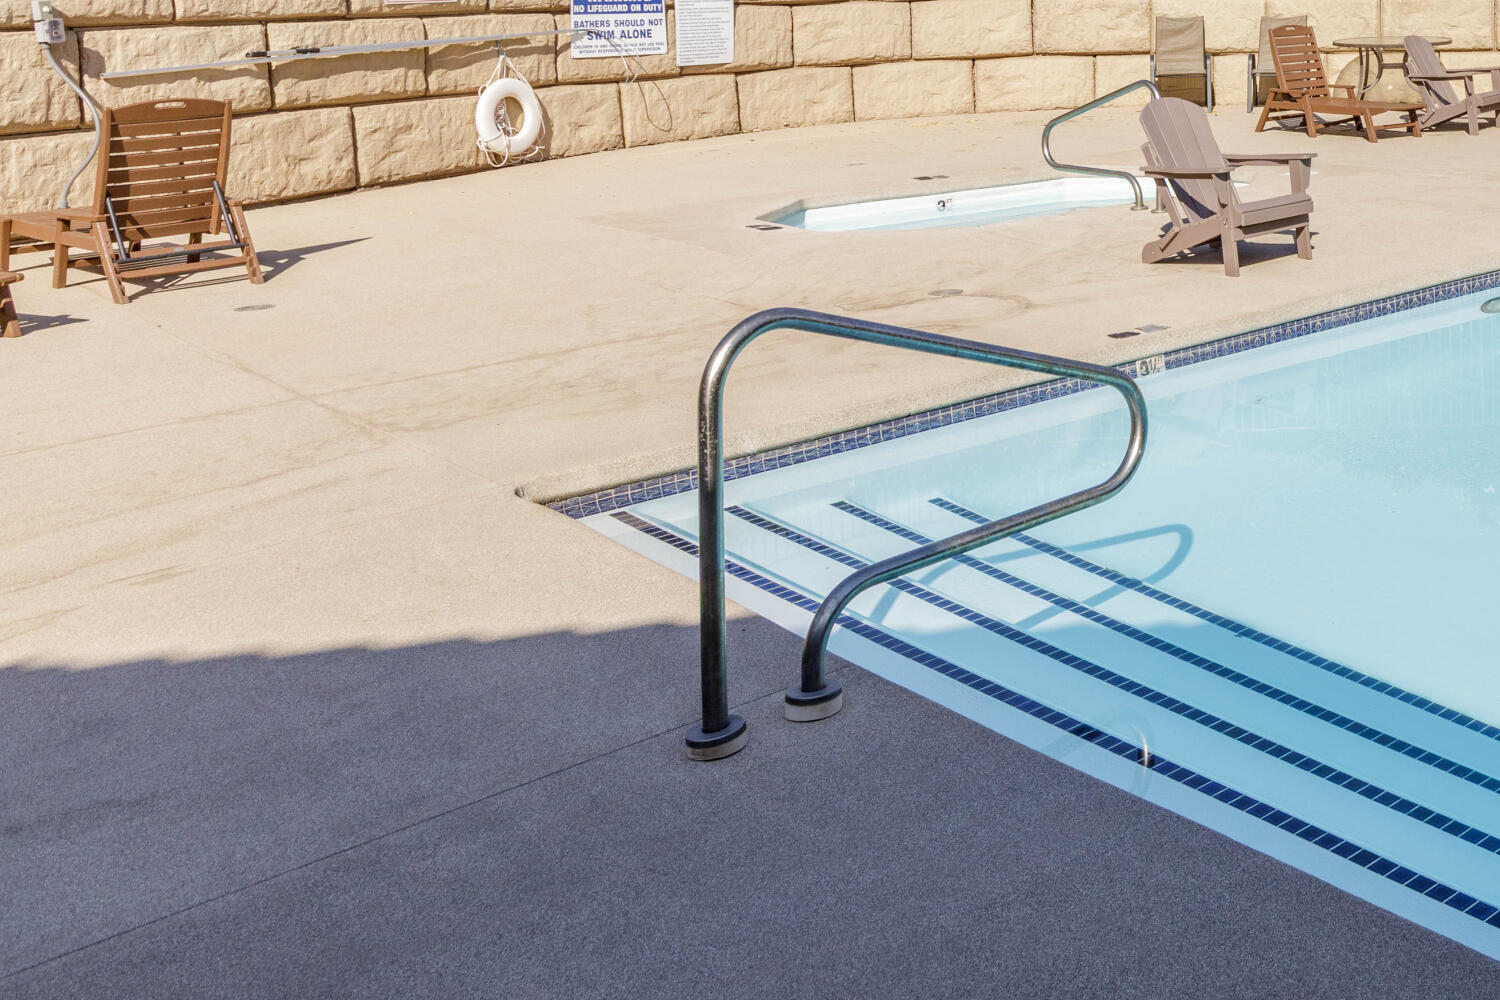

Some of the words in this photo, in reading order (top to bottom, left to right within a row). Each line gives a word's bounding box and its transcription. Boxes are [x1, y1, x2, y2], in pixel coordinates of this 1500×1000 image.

[574, 4, 585, 13] NO
[587, 4, 628, 12] LIFEGUARD
[574, 20, 610, 28] BATHERS
[614, 19, 645, 27] SHOULD
[587, 30, 615, 40] SWIM
[620, 29, 653, 39] ALONE
